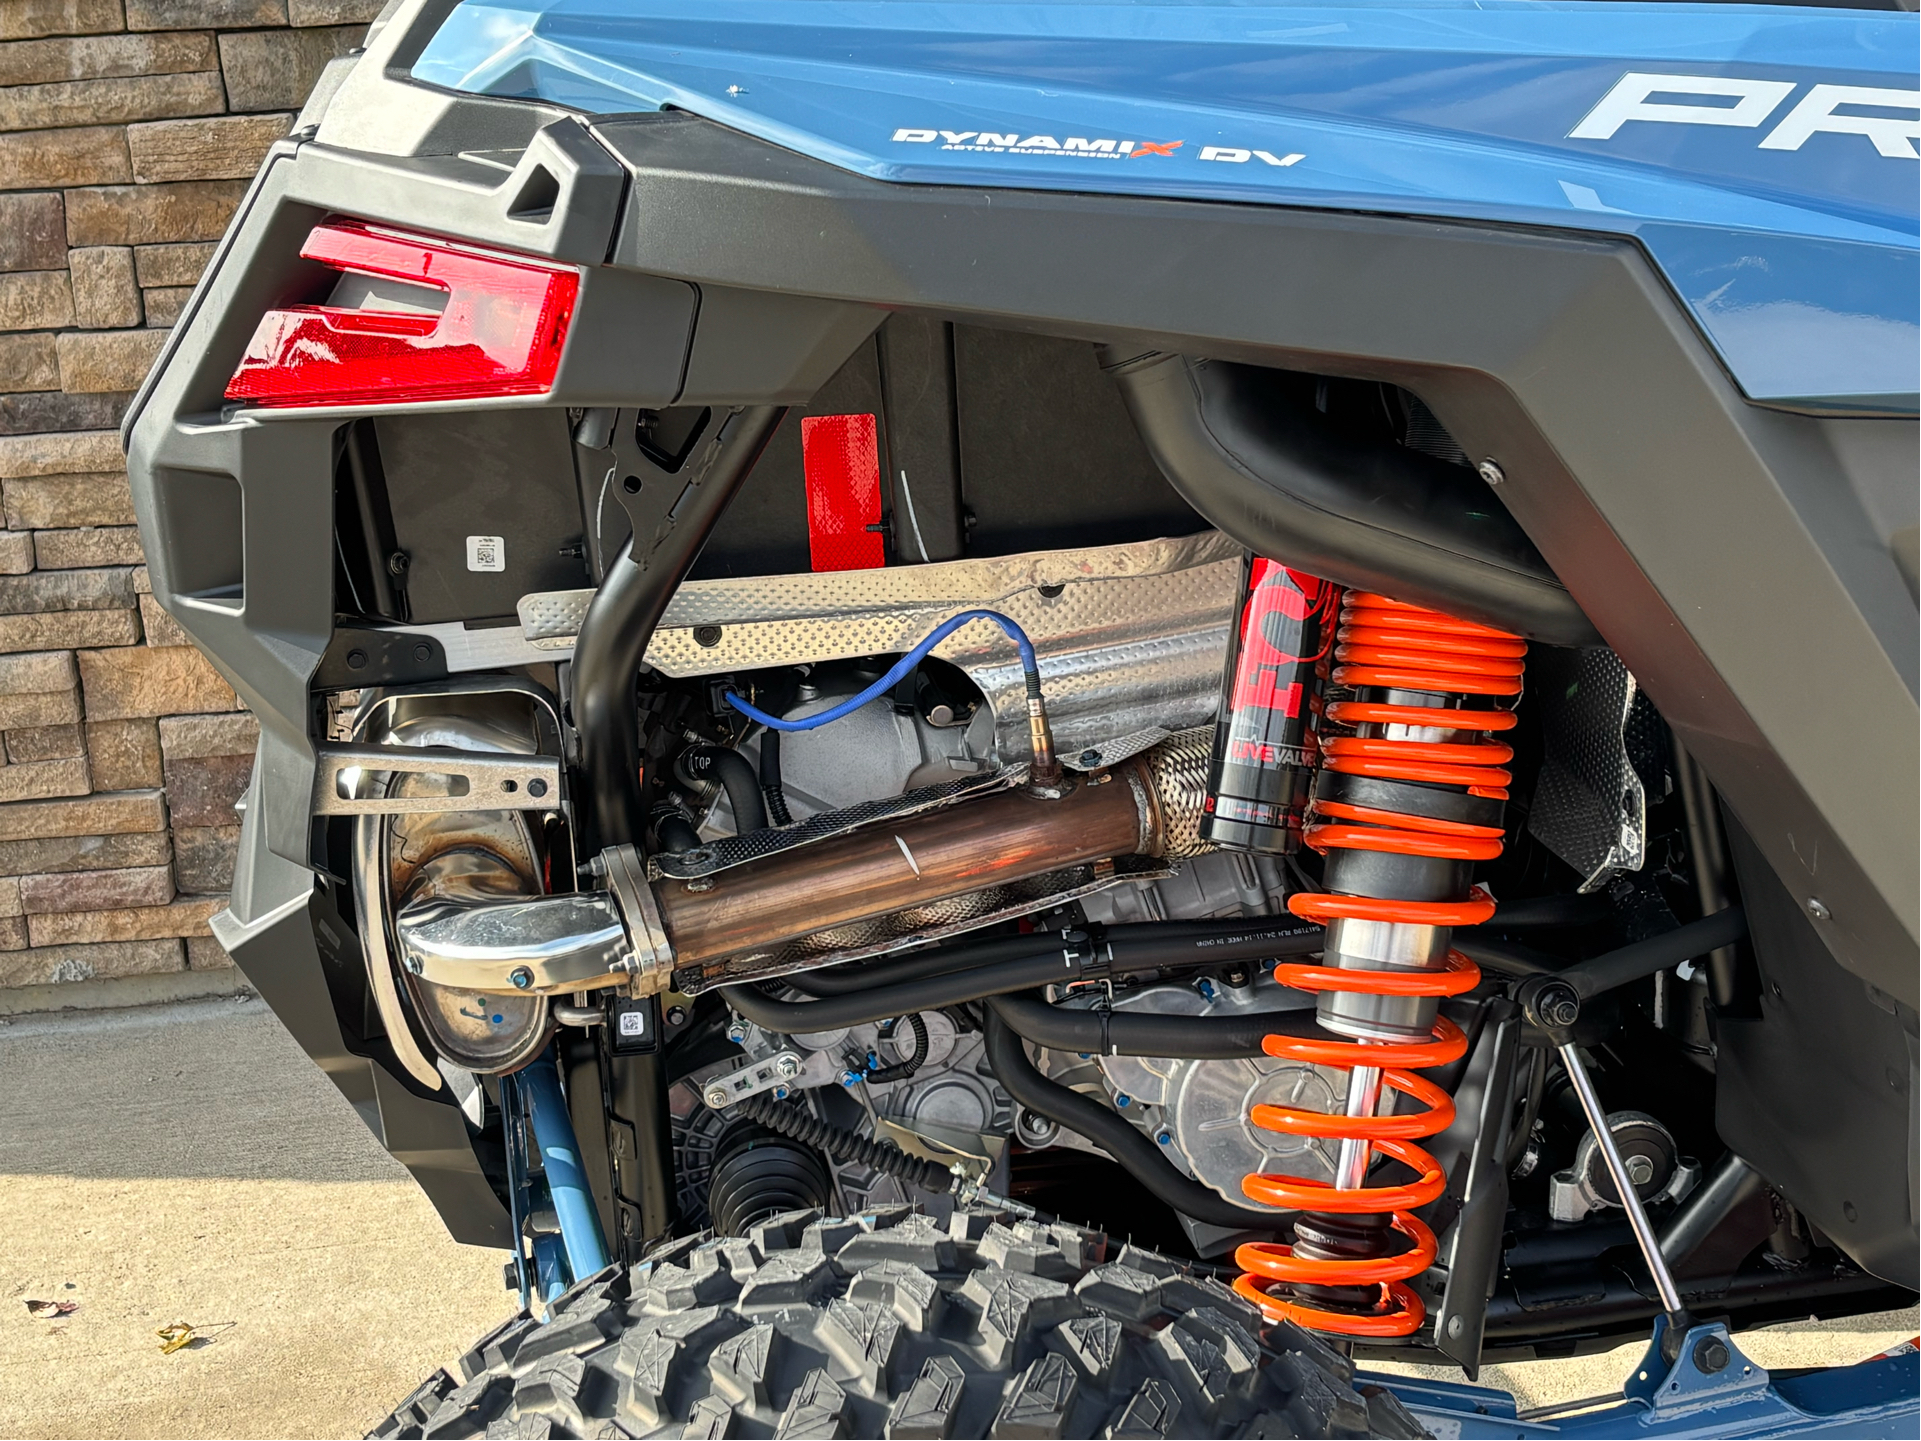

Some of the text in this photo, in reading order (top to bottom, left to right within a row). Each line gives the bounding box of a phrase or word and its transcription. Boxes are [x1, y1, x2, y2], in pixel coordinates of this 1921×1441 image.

[1568, 72, 1920, 159] PR
[892, 128, 1307, 167] DYNAMIX DV
[941, 144, 1121, 160] ACTIVE SUSPENSION
[694, 756, 711, 770] TOP
[1196, 938, 1215, 947] CHINA
